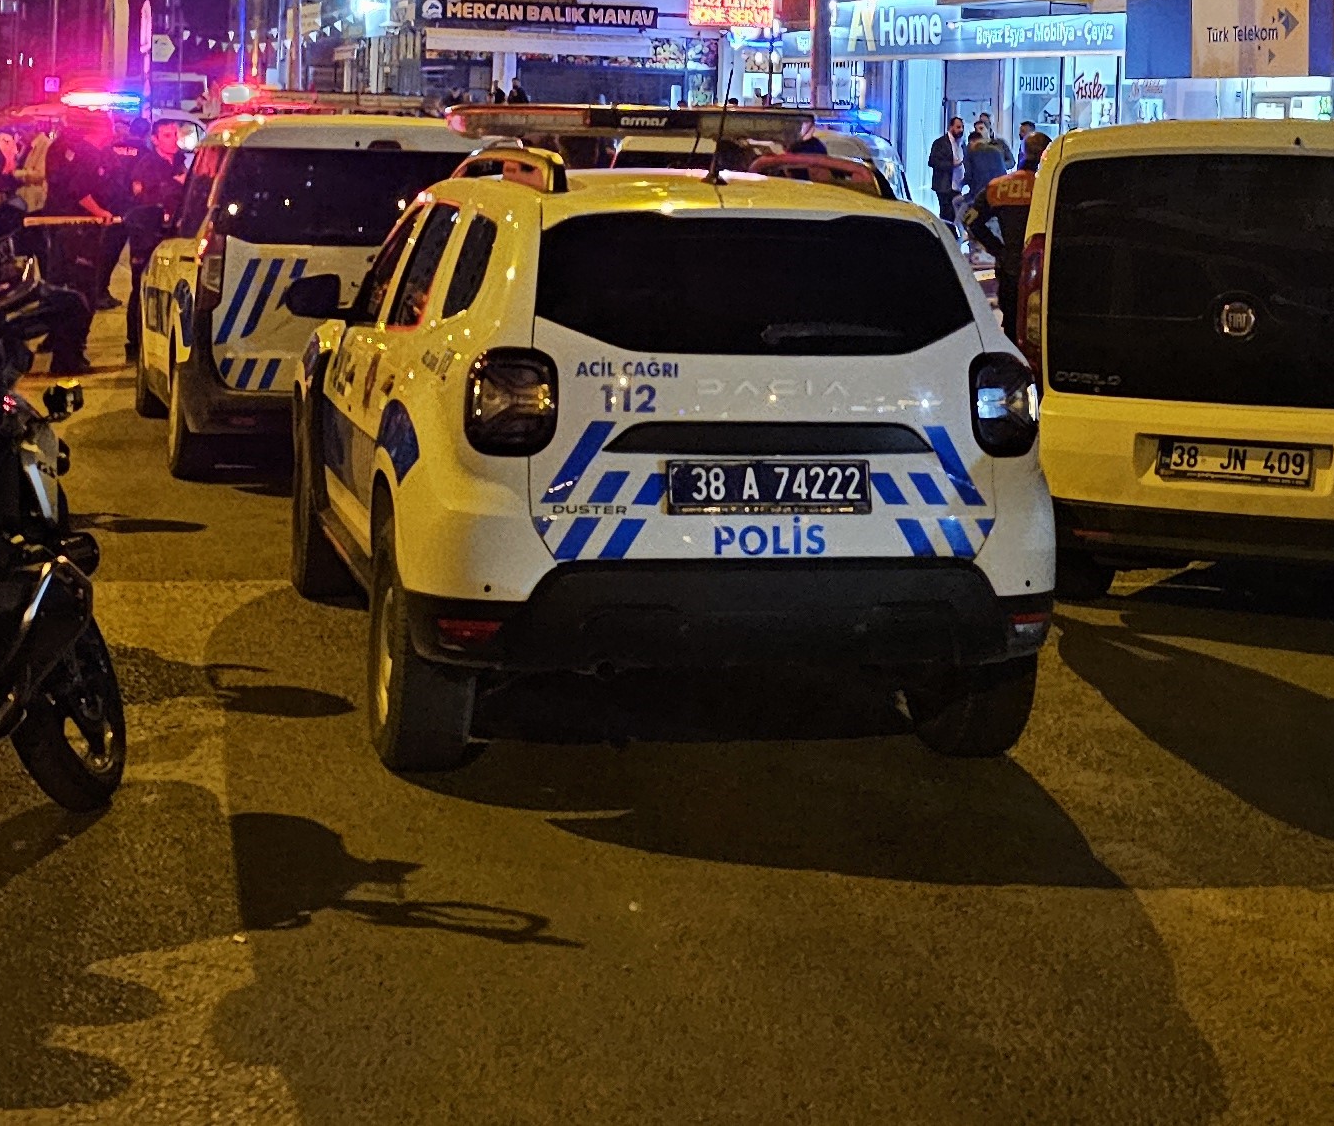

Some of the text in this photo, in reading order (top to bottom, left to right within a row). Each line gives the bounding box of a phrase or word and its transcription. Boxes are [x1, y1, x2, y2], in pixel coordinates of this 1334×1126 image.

[446, 0, 655, 27] MERCAN BALIK MANAV
[879, 7, 942, 47] Home
[1033, 22, 1075, 46] Mobilya
[1084, 20, 1114, 45] Çeyiz
[1207, 25, 1279, 43] Türk Telekom
[1019, 76, 1055, 93] PHILIPS
[996, 179, 1031, 199] POL
[1228, 312, 1247, 328] FIAT
[576, 358, 616, 378] ACİL
[601, 384, 656, 414] 112
[696, 379, 849, 396] DACIA
[1172, 446, 1305, 475] 38 JN 409
[691, 467, 862, 501] 38 A 74222
[552, 505, 627, 515] DUSTER
[714, 516, 826, 555] POLİS
